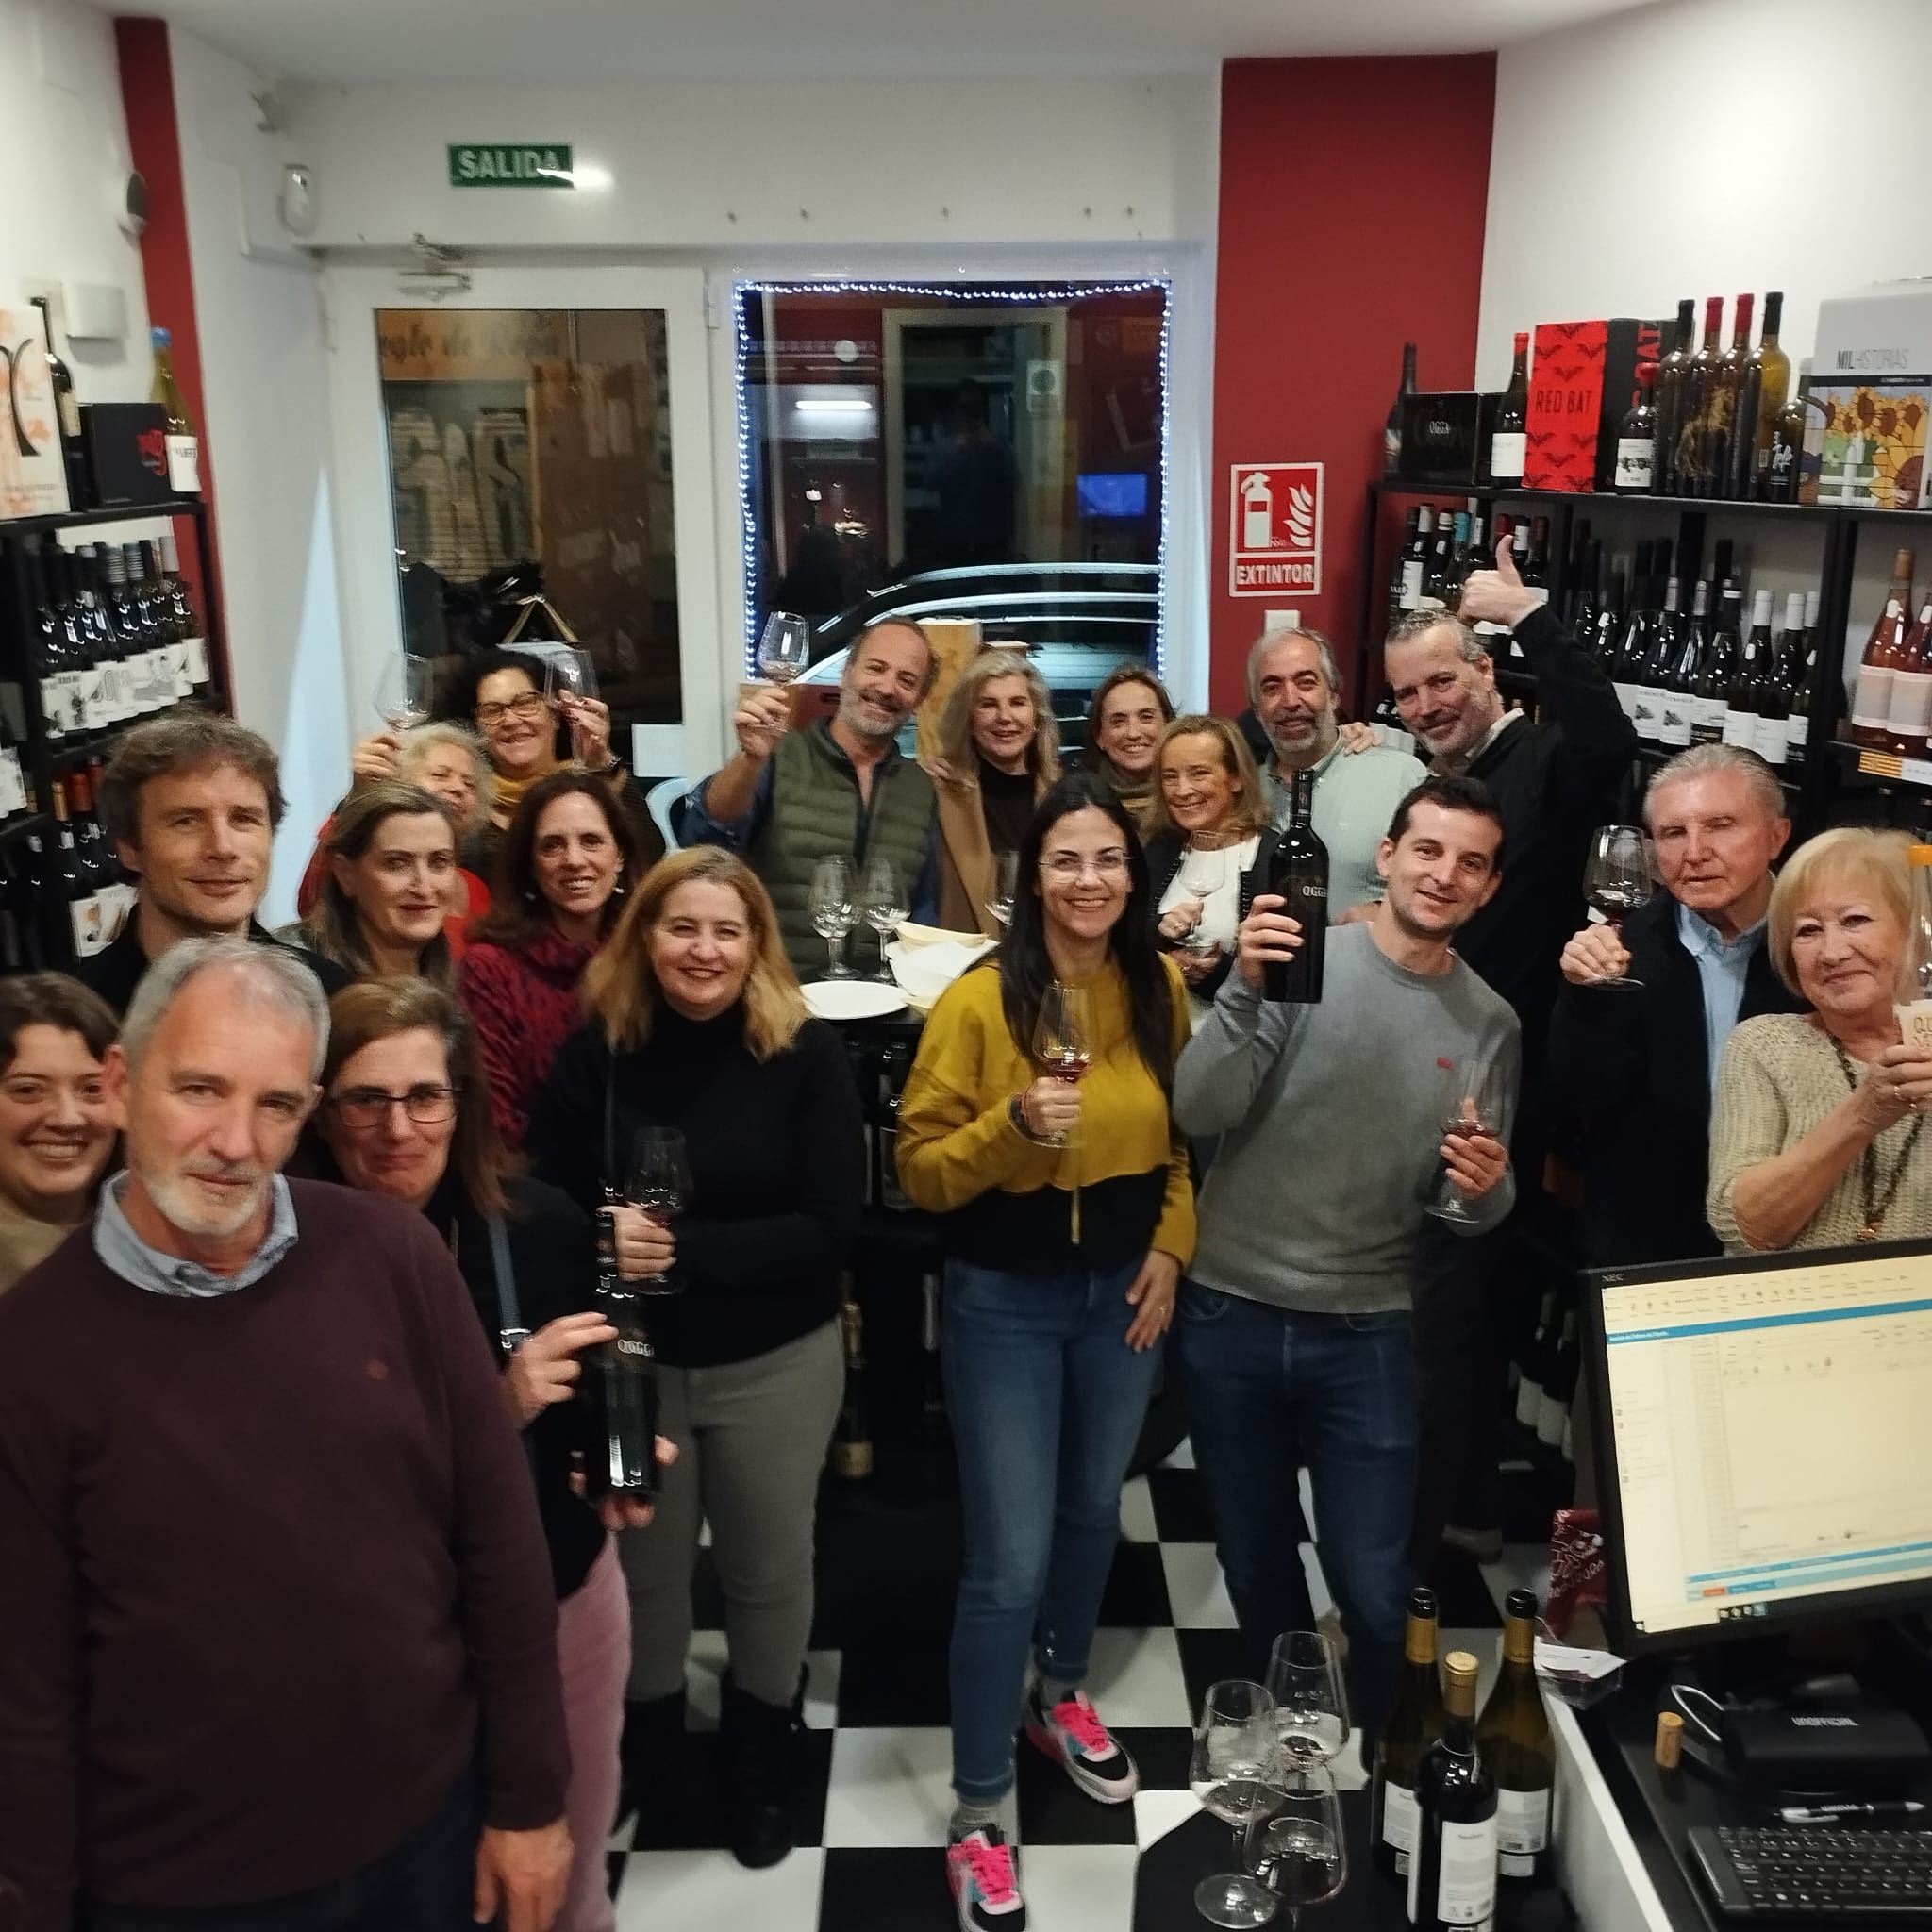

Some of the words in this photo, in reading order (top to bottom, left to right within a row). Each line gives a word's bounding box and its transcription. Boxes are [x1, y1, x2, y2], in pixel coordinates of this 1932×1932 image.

[458, 149, 559, 179] SALIDA
[1535, 390, 1562, 414] RED
[1566, 390, 1594, 415] BAT
[1236, 564, 1315, 585] EXTINTOR
